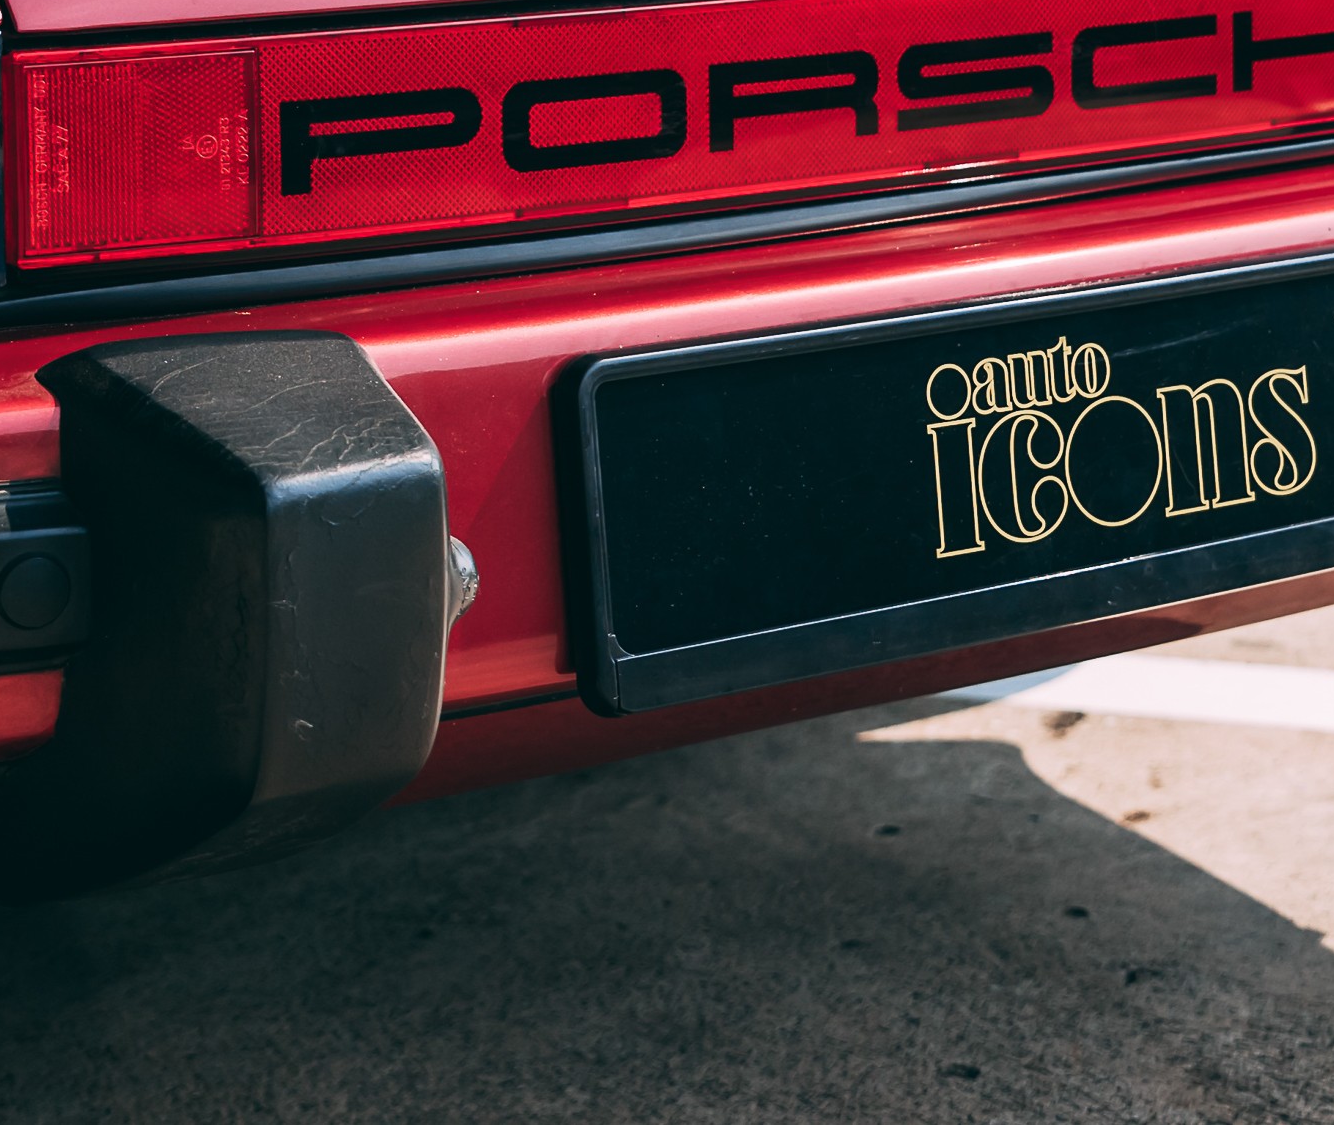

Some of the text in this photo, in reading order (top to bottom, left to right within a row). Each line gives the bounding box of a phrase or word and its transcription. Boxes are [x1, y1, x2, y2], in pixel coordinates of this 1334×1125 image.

[33, 106, 48, 173] GERMANY
[219, 117, 230, 134] R3
[56, 162, 70, 194] SAE
[219, 138, 231, 175] 21343
[35, 182, 49, 229] BOSCH
[972, 335, 1111, 415] auto
[926, 362, 1318, 559] icons
